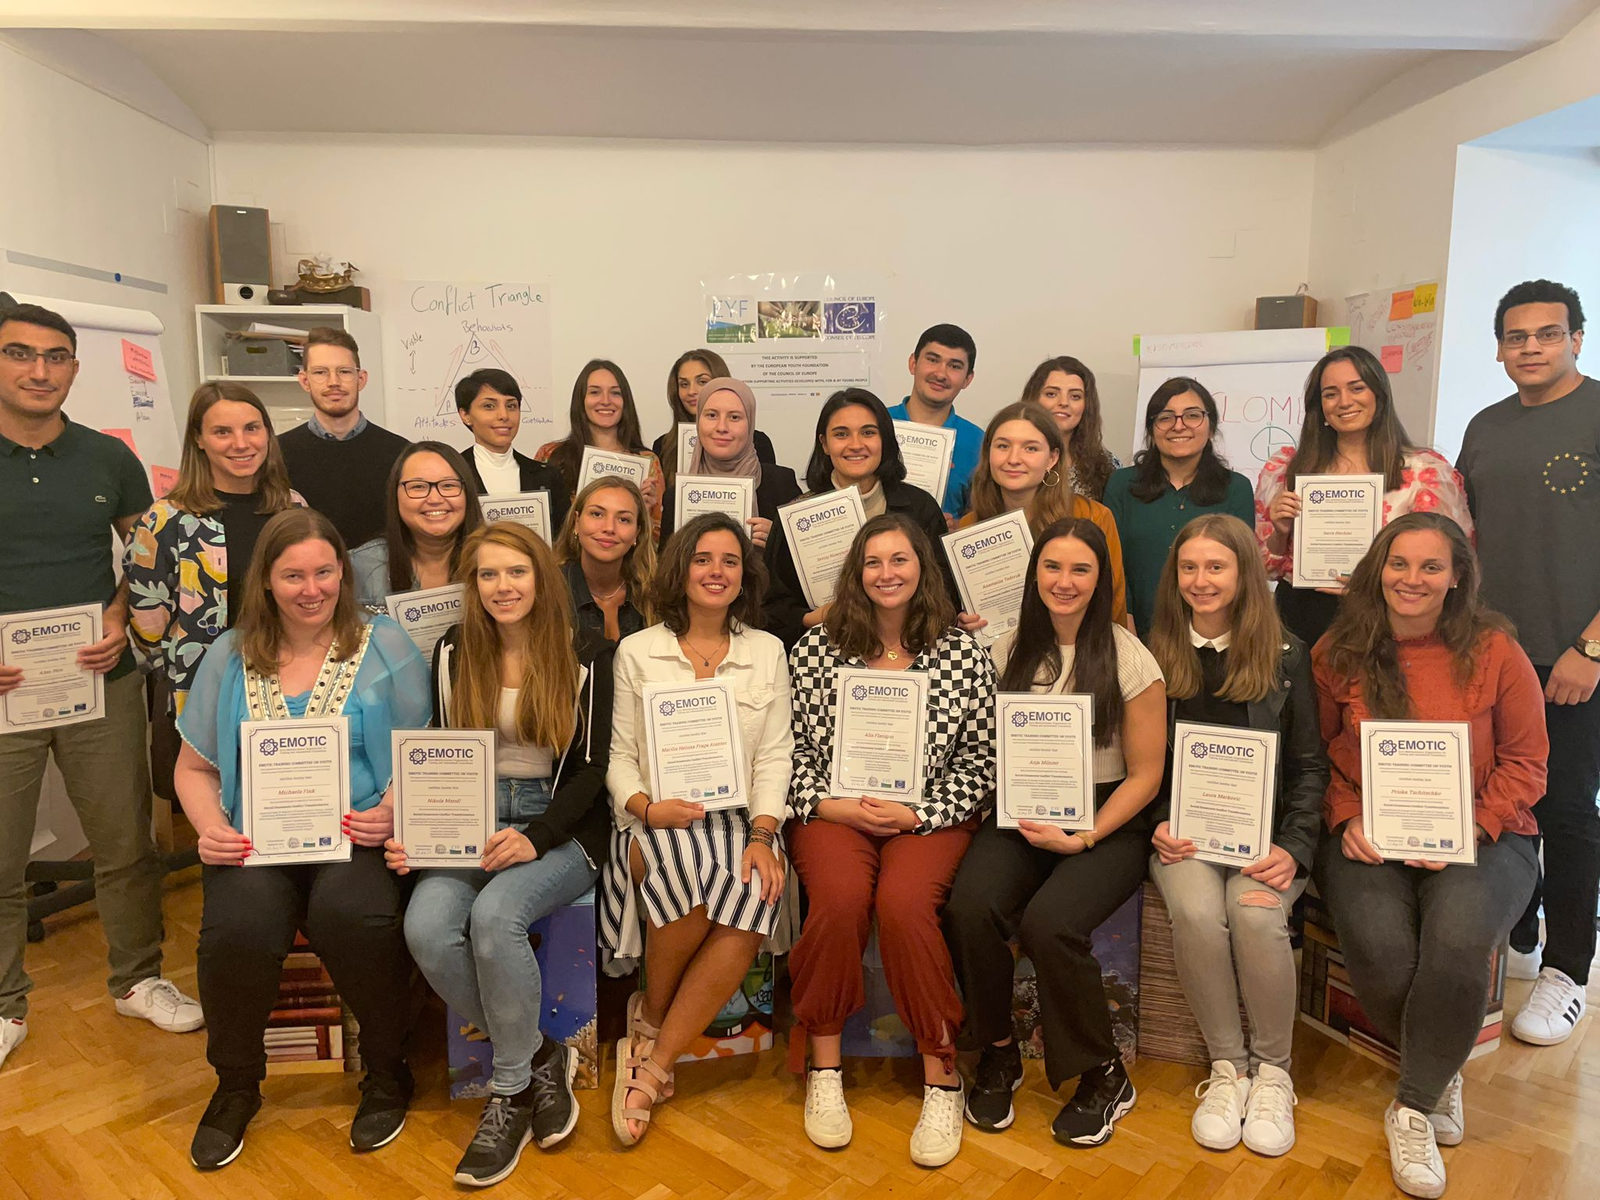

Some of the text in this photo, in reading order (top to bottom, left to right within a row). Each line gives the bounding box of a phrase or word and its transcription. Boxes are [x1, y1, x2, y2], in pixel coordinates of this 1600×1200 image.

[411, 284, 544, 316] Conflict Triangle
[605, 464, 636, 475] EMOTIC
[702, 490, 737, 500] EMOTIC
[1326, 490, 1365, 498] EMOTIC
[501, 506, 534, 515] EMOTIC
[810, 506, 846, 523] EMOTIC
[975, 530, 1013, 549] EMOTIC
[420, 600, 461, 614] EMOTIC
[32, 622, 81, 636] EMOTIC
[868, 686, 908, 697] EMOTIC
[676, 696, 716, 708] EMOTIC
[1029, 712, 1072, 721] EMOTIC
[279, 736, 327, 747] EMOTIC
[1398, 740, 1446, 750] EMOTIC
[428, 749, 474, 758] EMOTIC
[1209, 744, 1254, 757] EMOTIC
